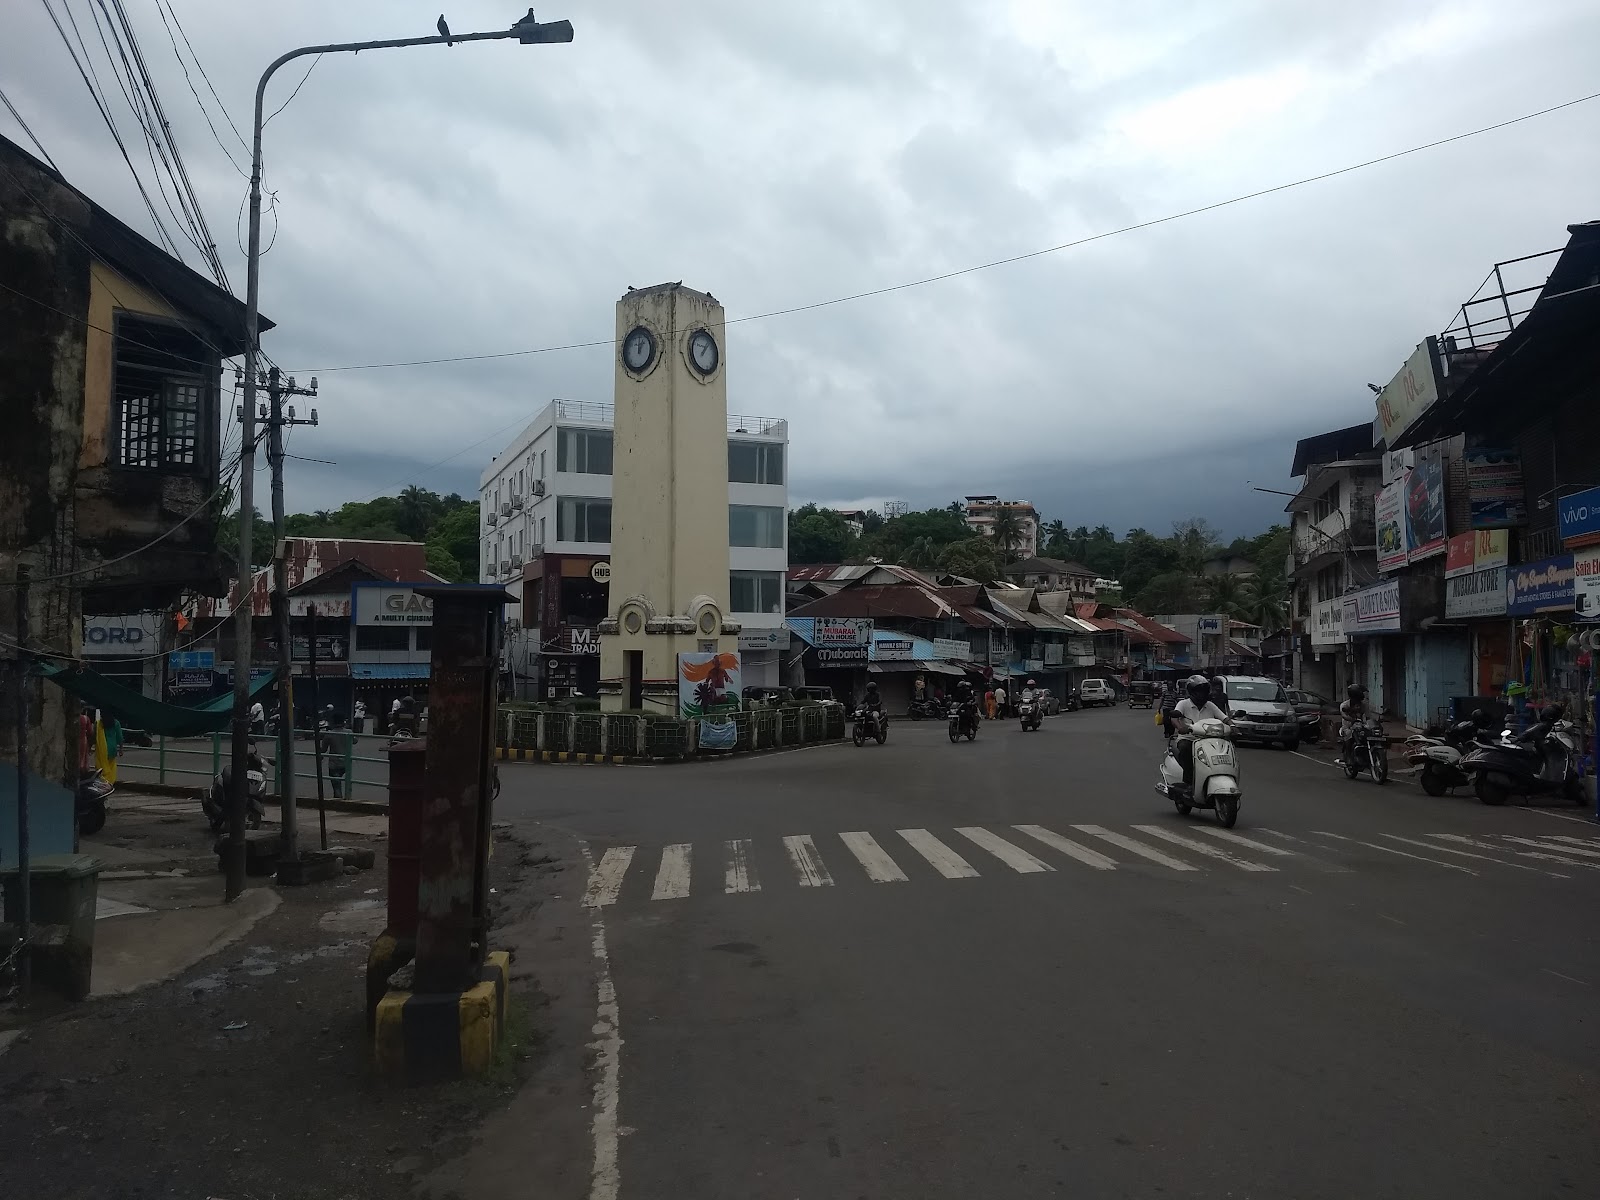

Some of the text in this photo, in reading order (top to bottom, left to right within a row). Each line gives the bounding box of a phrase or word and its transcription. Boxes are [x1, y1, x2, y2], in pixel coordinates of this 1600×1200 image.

[1564, 506, 1588, 524] vivo
[594, 568, 611, 577] HUB
[1453, 567, 1499, 598] MUBARAK STORE
[86, 627, 143, 643] ORD
[818, 648, 868, 660] Mubarak
